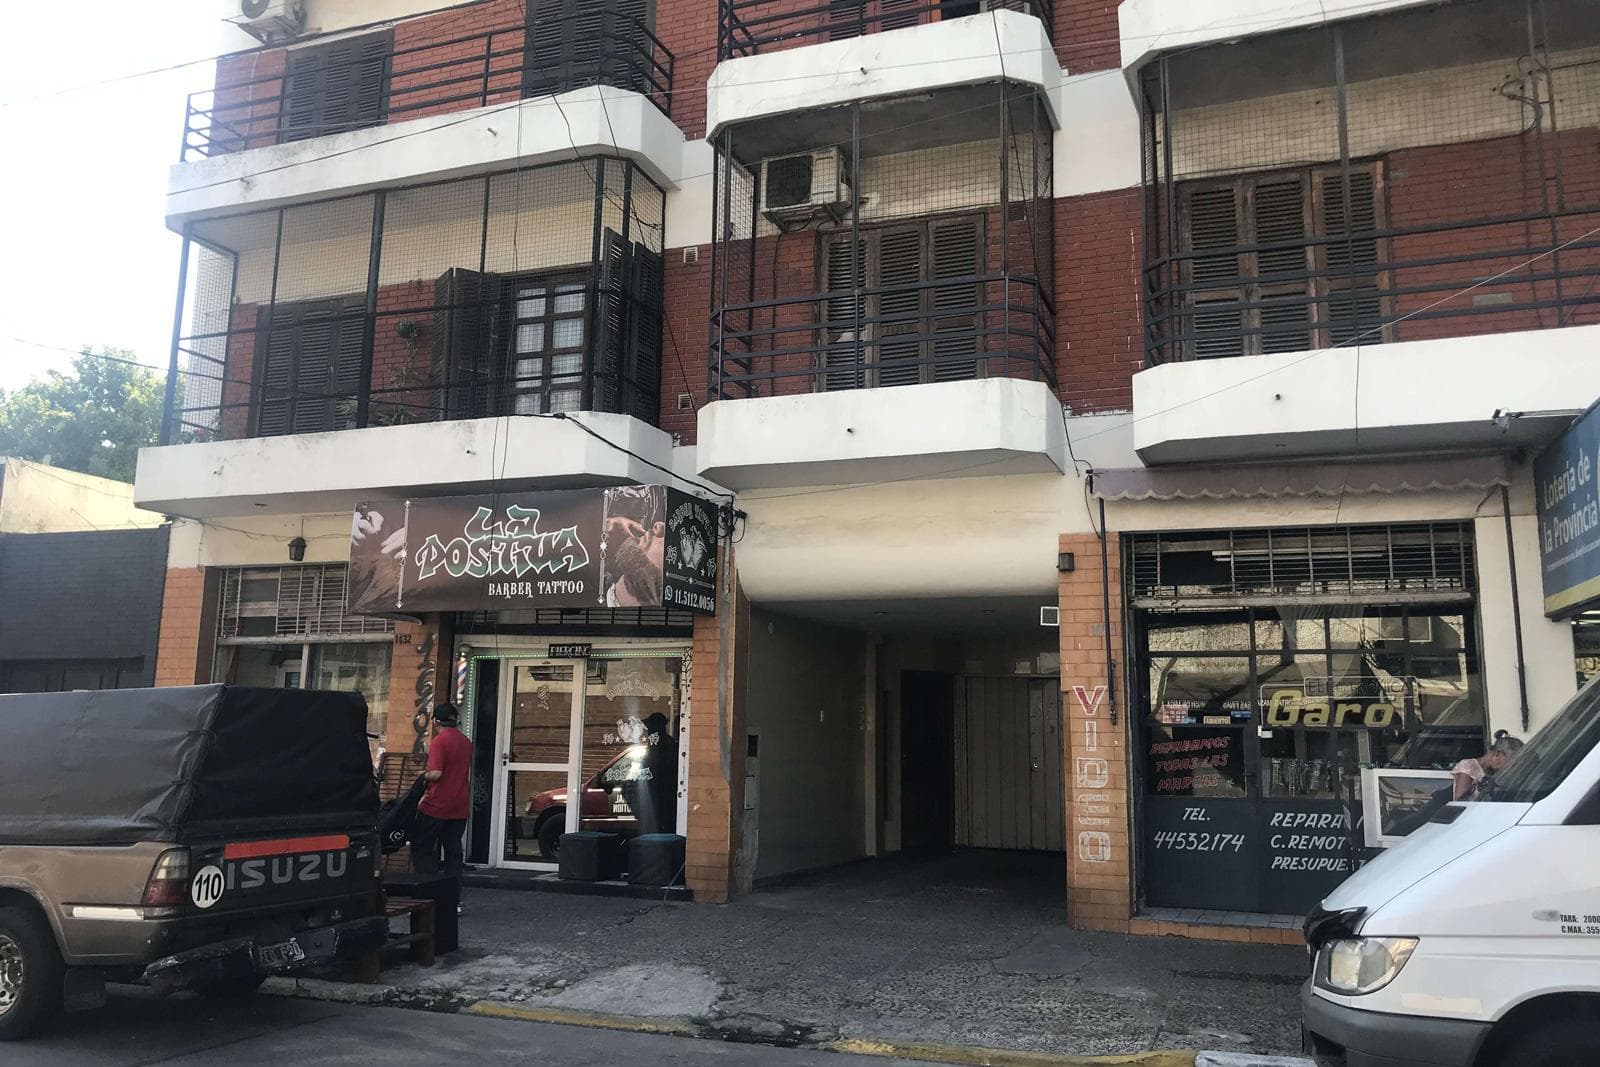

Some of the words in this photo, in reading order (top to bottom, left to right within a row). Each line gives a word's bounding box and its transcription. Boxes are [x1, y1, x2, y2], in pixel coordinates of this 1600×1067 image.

[1577, 448, 1591, 486] de
[1543, 522, 1553, 554] la
[1553, 493, 1598, 549] Provincia
[488, 581, 533, 598] BARBER
[537, 580, 584, 595] TATTOO
[395, 634, 412, 645] 1632
[550, 646, 591, 657] PIERCING
[1266, 689, 1395, 727] Garo
[1151, 736, 1231, 754] REPARAMOS
[1155, 757, 1198, 773] TODAS
[1201, 753, 1229, 767] LAS
[1072, 685, 1111, 863] VIDEO
[1157, 773, 1220, 791] MARCAS
[1183, 807, 1210, 821] TEL.
[1154, 830, 1245, 852] 44532174
[226, 852, 347, 890] ISUZU
[195, 873, 222, 902] 110
